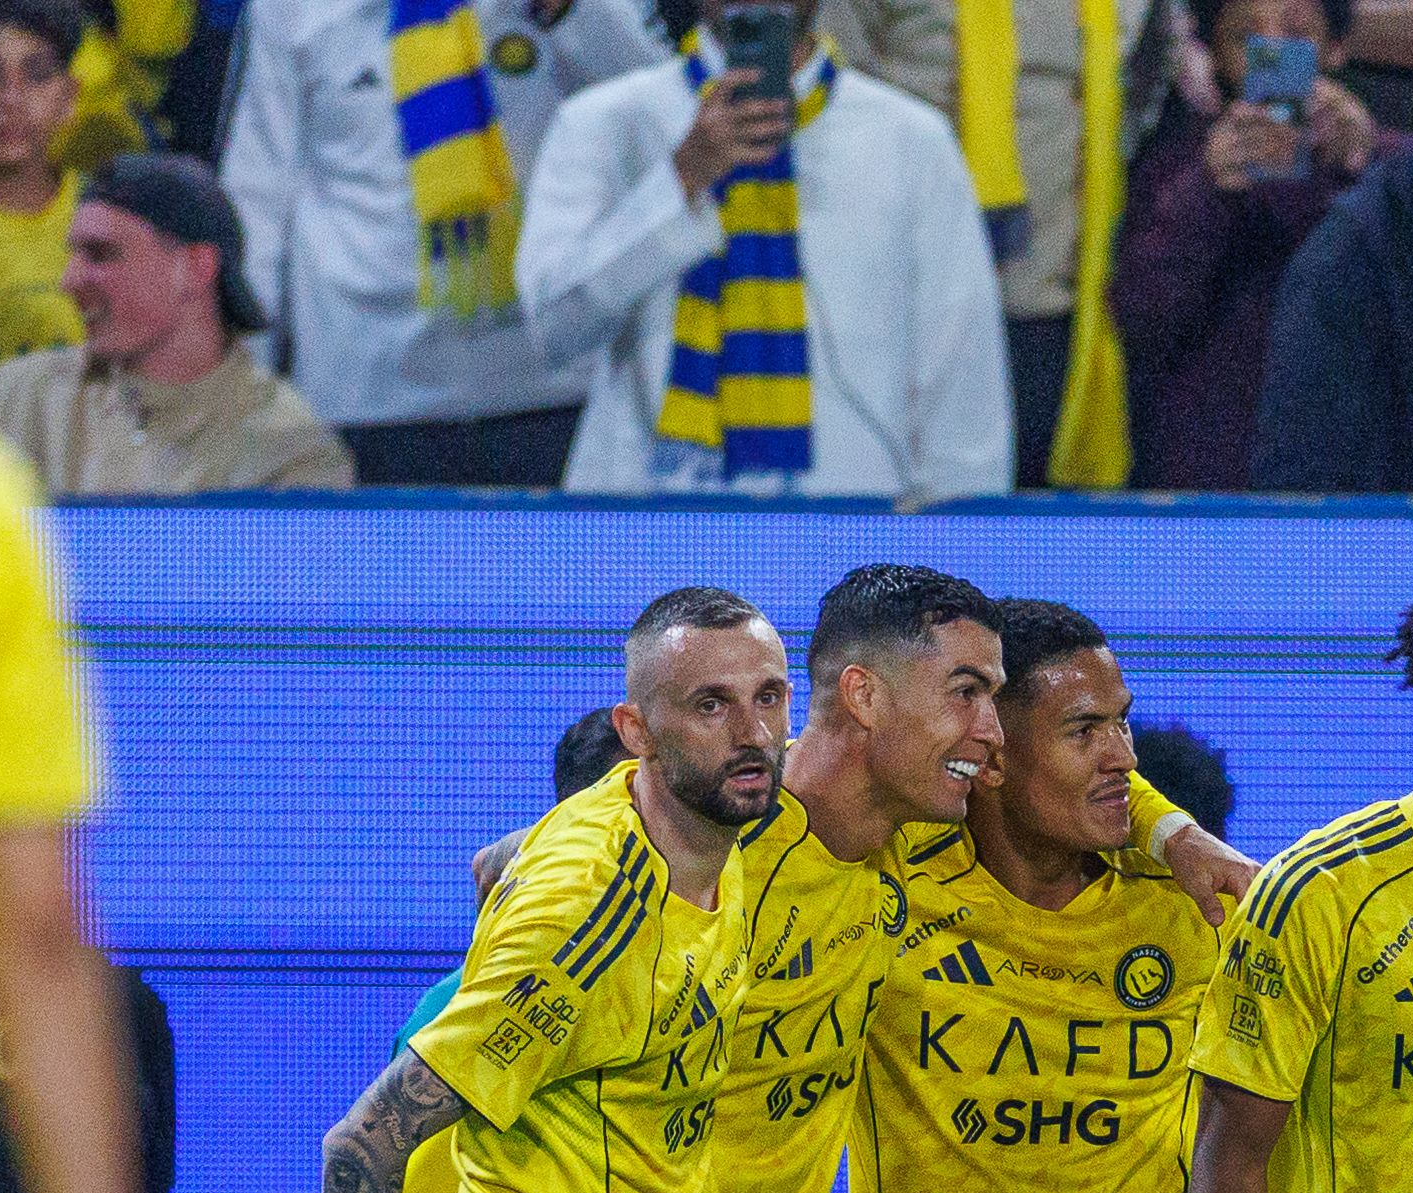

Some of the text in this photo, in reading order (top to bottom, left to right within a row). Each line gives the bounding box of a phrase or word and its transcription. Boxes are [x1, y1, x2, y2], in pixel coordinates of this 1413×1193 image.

[754, 905, 800, 979] Gathern
[524, 1004, 567, 1046] NOUG
[659, 953, 695, 1036] Gathern
[919, 1011, 1173, 1080] KAFD
[991, 1098, 1121, 1146] SHG
